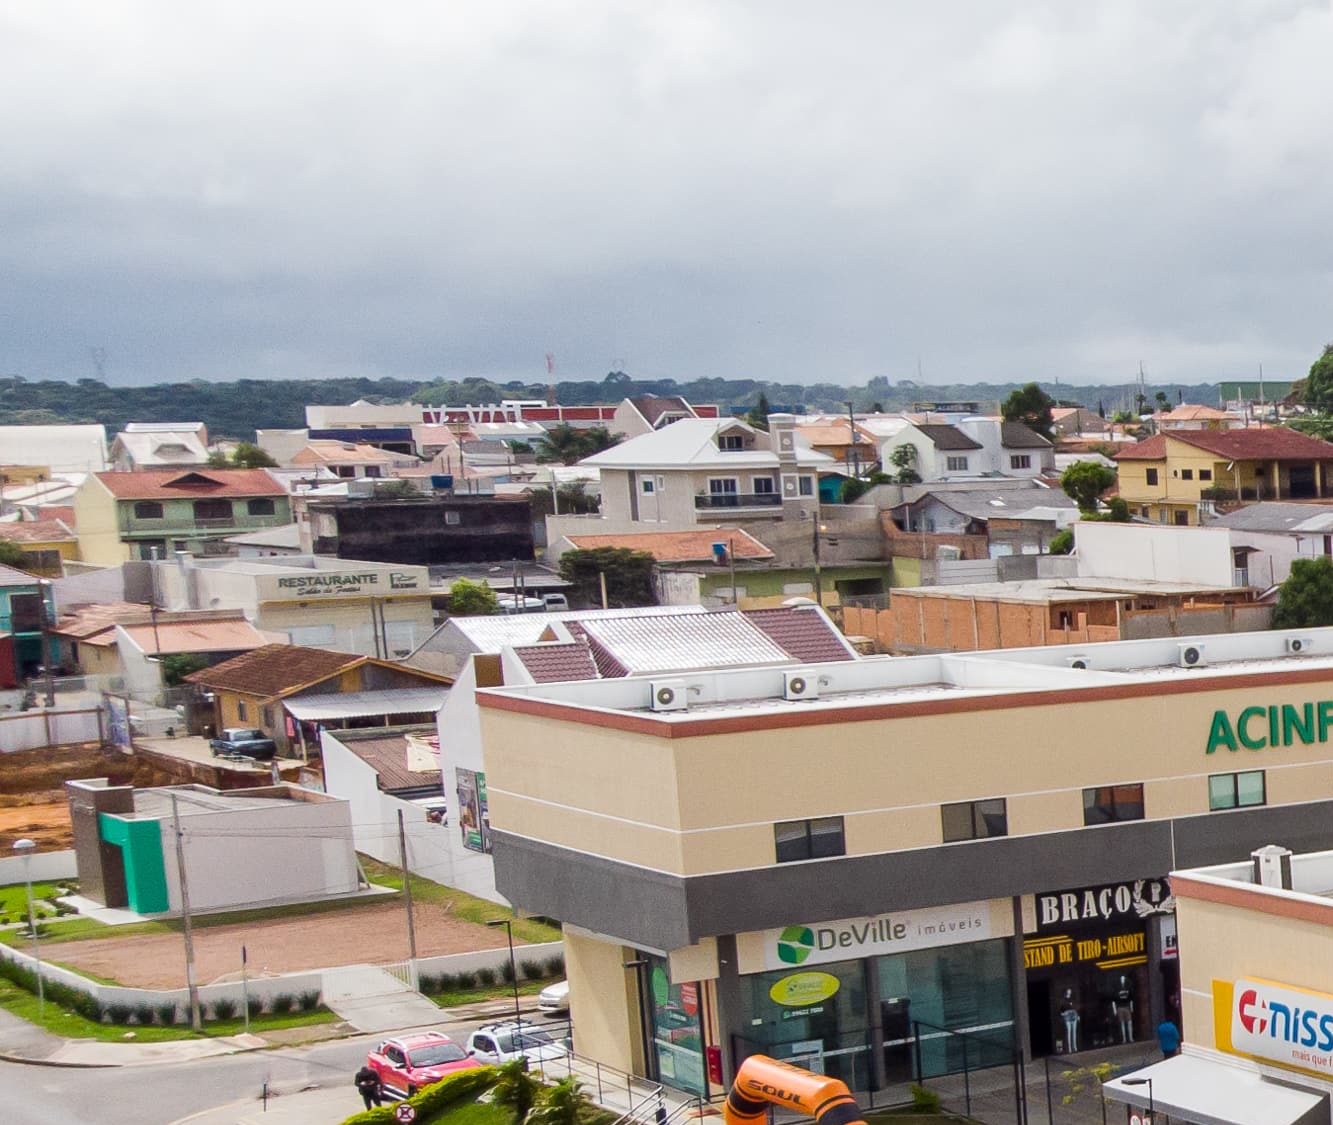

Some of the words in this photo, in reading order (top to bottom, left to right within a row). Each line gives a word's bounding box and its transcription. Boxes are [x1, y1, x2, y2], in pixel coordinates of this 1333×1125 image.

[278, 574, 378, 588] RESTAURANTE
[1040, 885, 1132, 925] BRAÇO
[818, 918, 907, 951] DeVille
[918, 917, 982, 936] imóveis
[1059, 943, 1073, 963] DE
[1292, 1050, 1310, 1062] mais
[1312, 1055, 1328, 1068] que
[747, 1080, 809, 1108] SOUL
